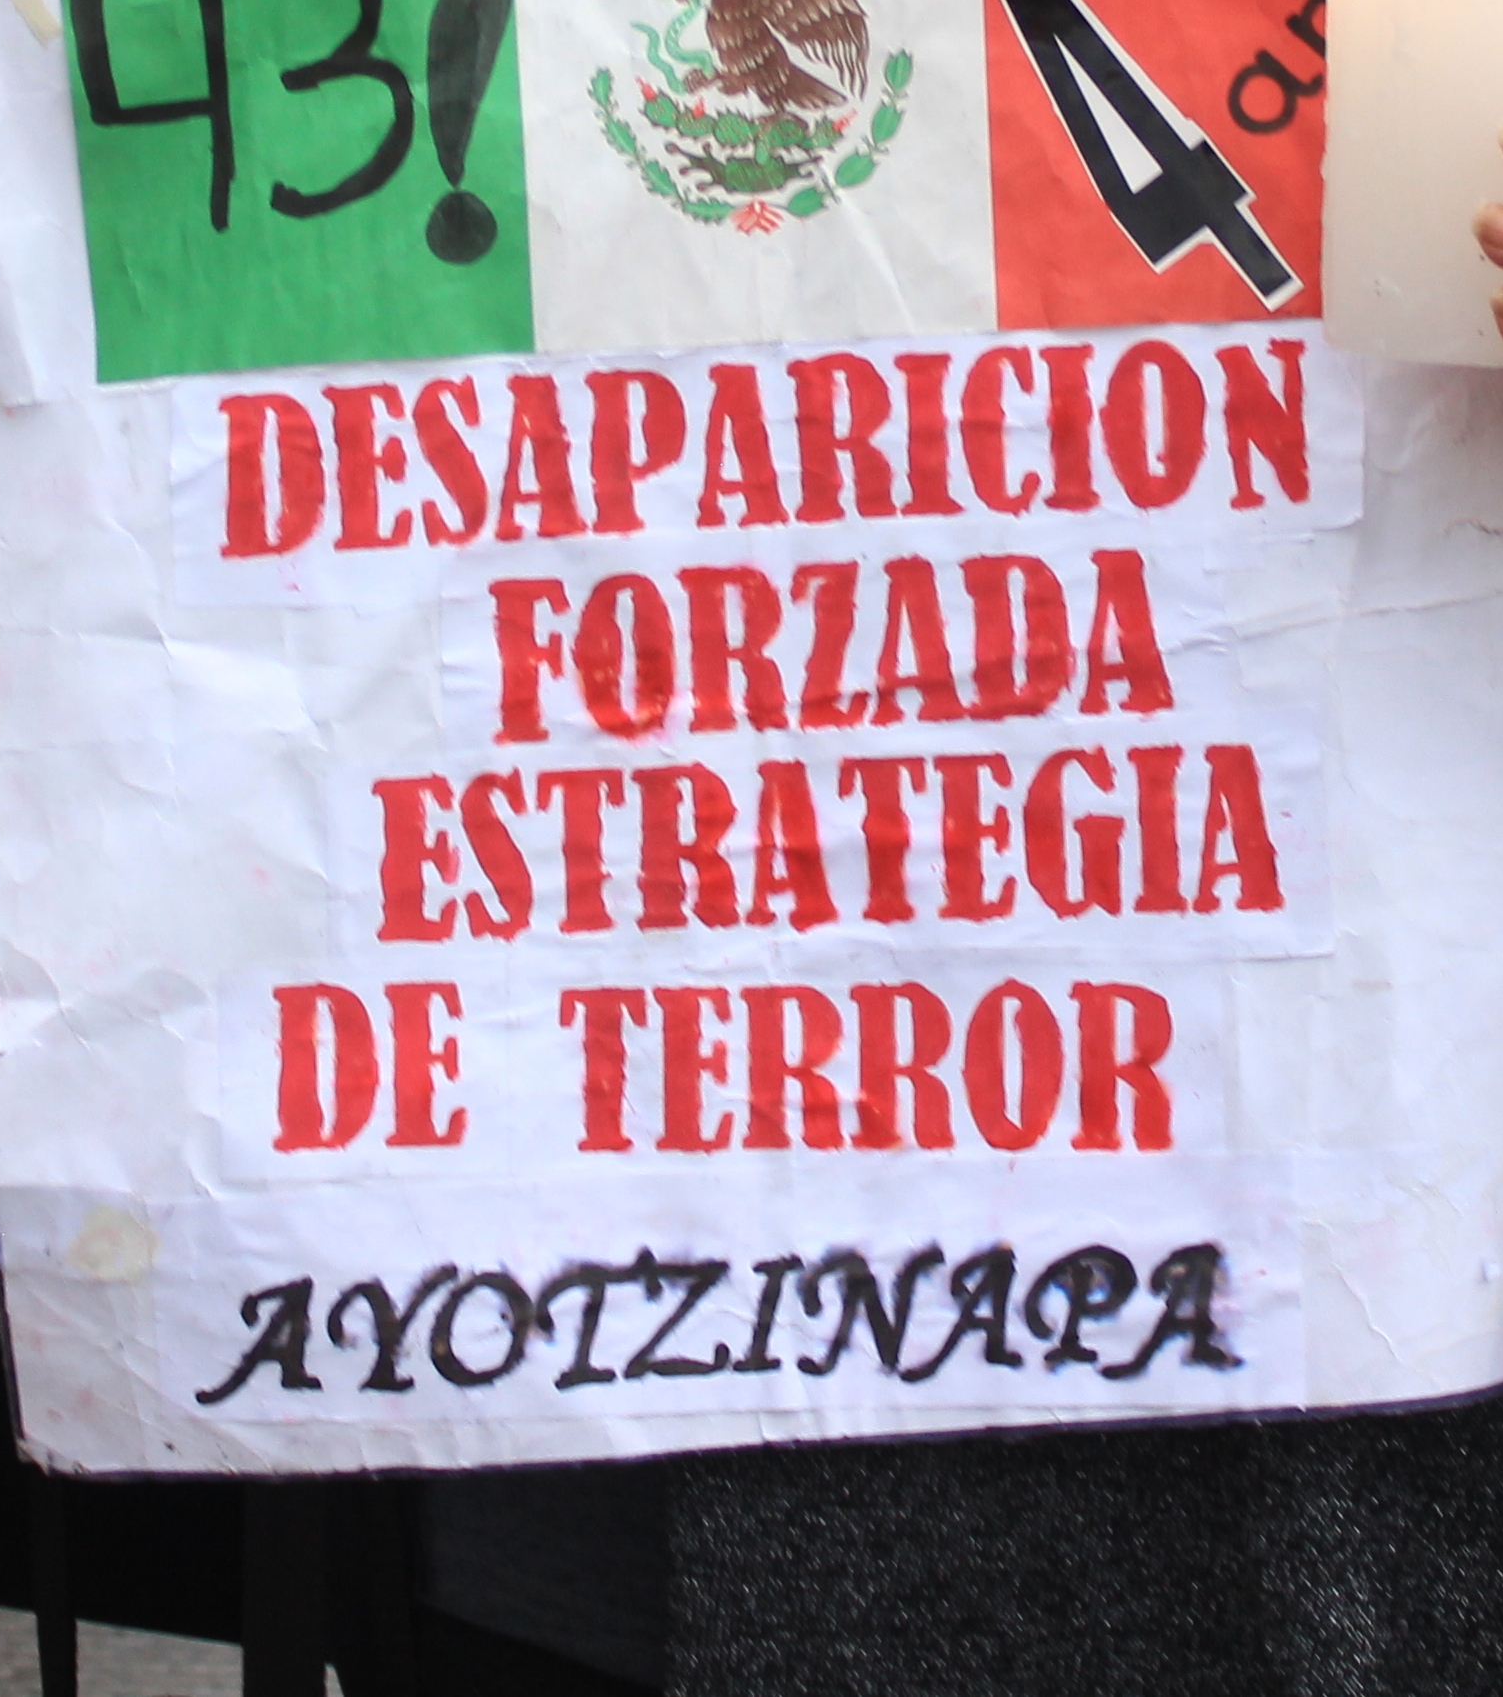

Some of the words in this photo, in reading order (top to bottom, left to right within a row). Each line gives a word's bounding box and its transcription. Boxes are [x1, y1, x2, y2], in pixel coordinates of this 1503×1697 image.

[219, 338, 1310, 559] DESAPARICION
[488, 548, 1174, 745] FORZADA
[372, 744, 1285, 944] ESTRATEGIA
[272, 981, 468, 1153] DE
[559, 978, 1175, 1153] TERROR
[195, 1242, 1245, 1406] AYOTZINAPA
